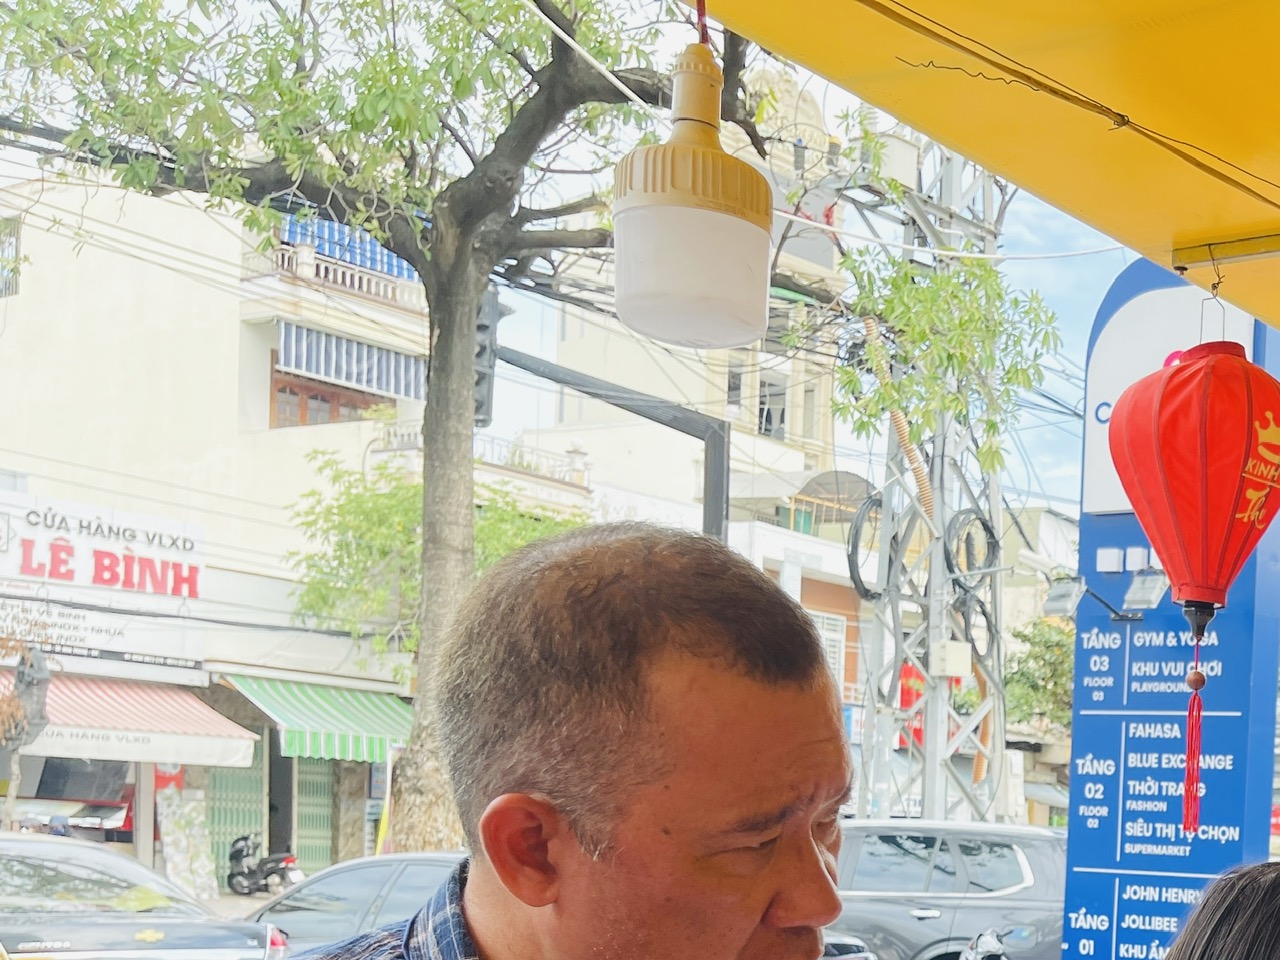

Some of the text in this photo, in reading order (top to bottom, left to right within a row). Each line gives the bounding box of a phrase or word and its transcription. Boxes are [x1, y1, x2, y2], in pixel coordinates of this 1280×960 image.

[1245, 458, 1280, 481] KINH
[26, 507, 195, 551] CỬA HÀNG VLXD
[20, 536, 200, 599] LÊ BÌNH
[1081, 627, 1122, 649] TẦNG
[1133, 631, 1164, 647] GYM
[1166, 631, 1178, 647] &
[1090, 656, 1109, 672] 03
[1132, 662, 1159, 676] KHU
[1161, 661, 1185, 676] VUI
[1084, 677, 1114, 687] FLOOR
[1092, 691, 1104, 701] 03
[1129, 723, 1181, 738] FAHASA
[1076, 755, 1115, 776] TẦNG
[1128, 753, 1234, 770] BLUE EXCANGE
[1084, 783, 1104, 799] 02
[1128, 776, 1207, 797] THỜI TRAG
[1079, 806, 1109, 817] FLOOR
[1126, 800, 1167, 812] FASHION
[1087, 819, 1099, 829] 02
[1125, 818, 1152, 837] SIÊU
[1155, 823, 1175, 842] THỊ
[1198, 825, 1240, 844] CHỌN
[1124, 843, 1191, 857] SUPERMARKET
[1122, 885, 1159, 902] JOHN
[1069, 907, 1109, 931] TẦNG
[1121, 915, 1178, 931] JOLLIBEE
[1079, 939, 1094, 956] 01
[1119, 943, 1147, 959] KHU
